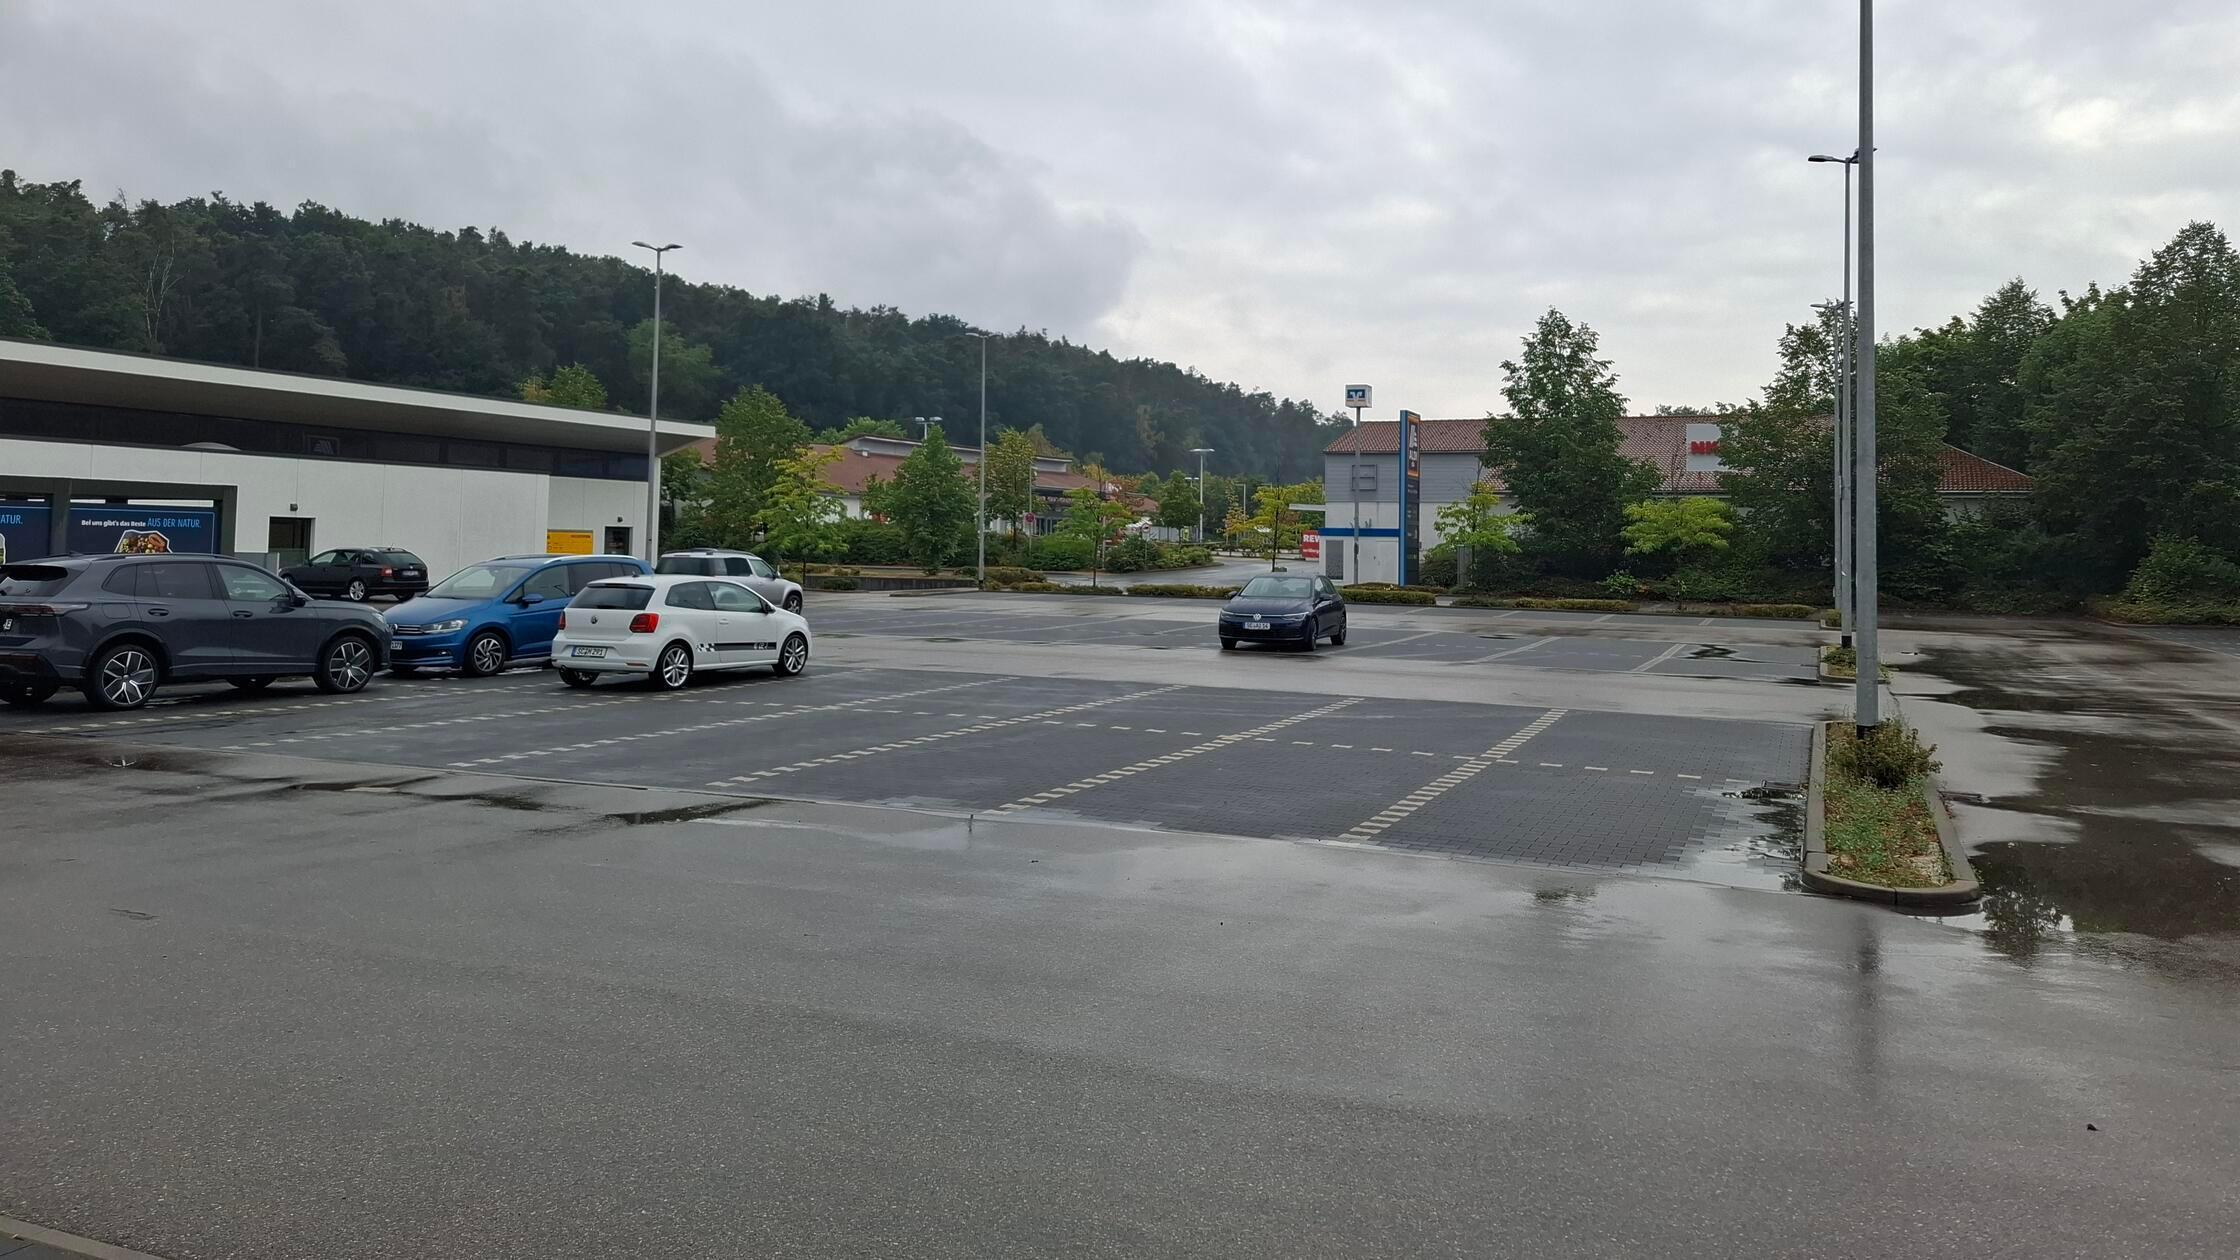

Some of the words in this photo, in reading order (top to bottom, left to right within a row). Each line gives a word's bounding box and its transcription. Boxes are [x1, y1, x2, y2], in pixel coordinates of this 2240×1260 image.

[103, 519, 119, 528] gibt's
[147, 517, 161, 527] AUS
[163, 518, 176, 528] DER
